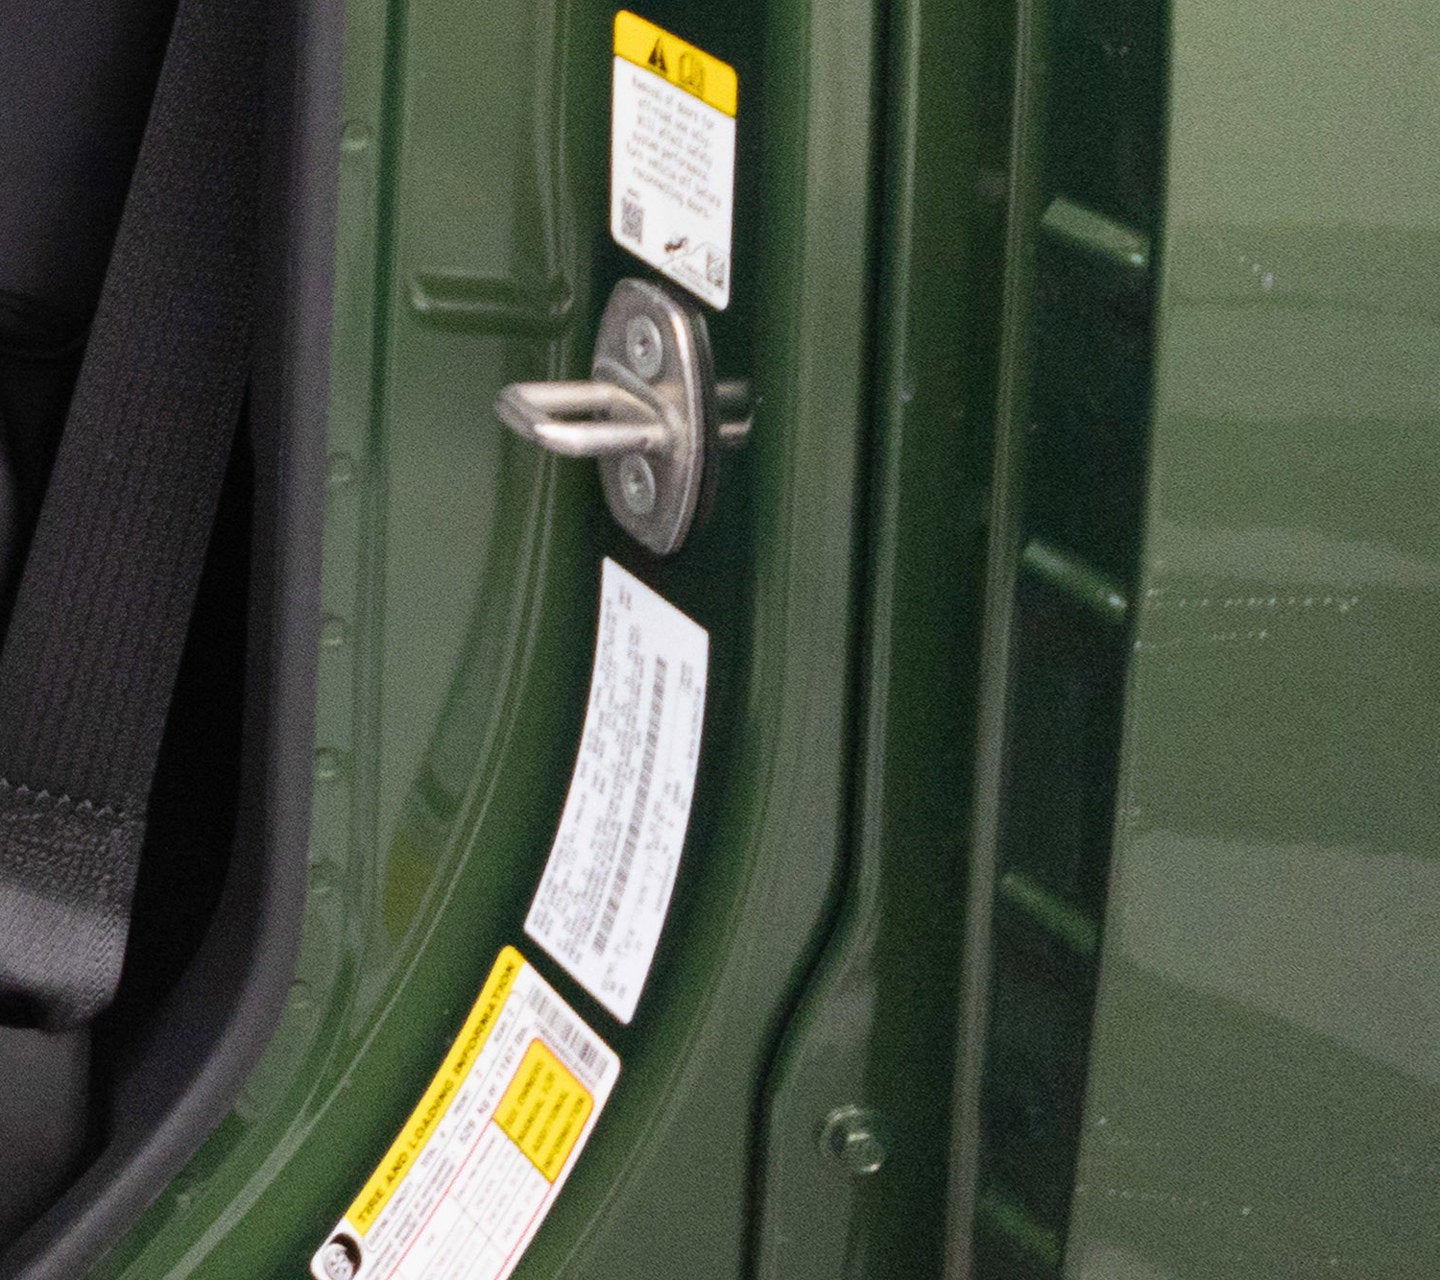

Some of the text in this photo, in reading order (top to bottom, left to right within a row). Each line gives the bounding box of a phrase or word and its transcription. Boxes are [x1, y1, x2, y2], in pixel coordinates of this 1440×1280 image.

[355, 961, 516, 1225] TIRE AND LOADING INFORMATION
[528, 1087, 571, 1153] ADDITIONAL
[540, 1096, 586, 1171] INFORMATION
